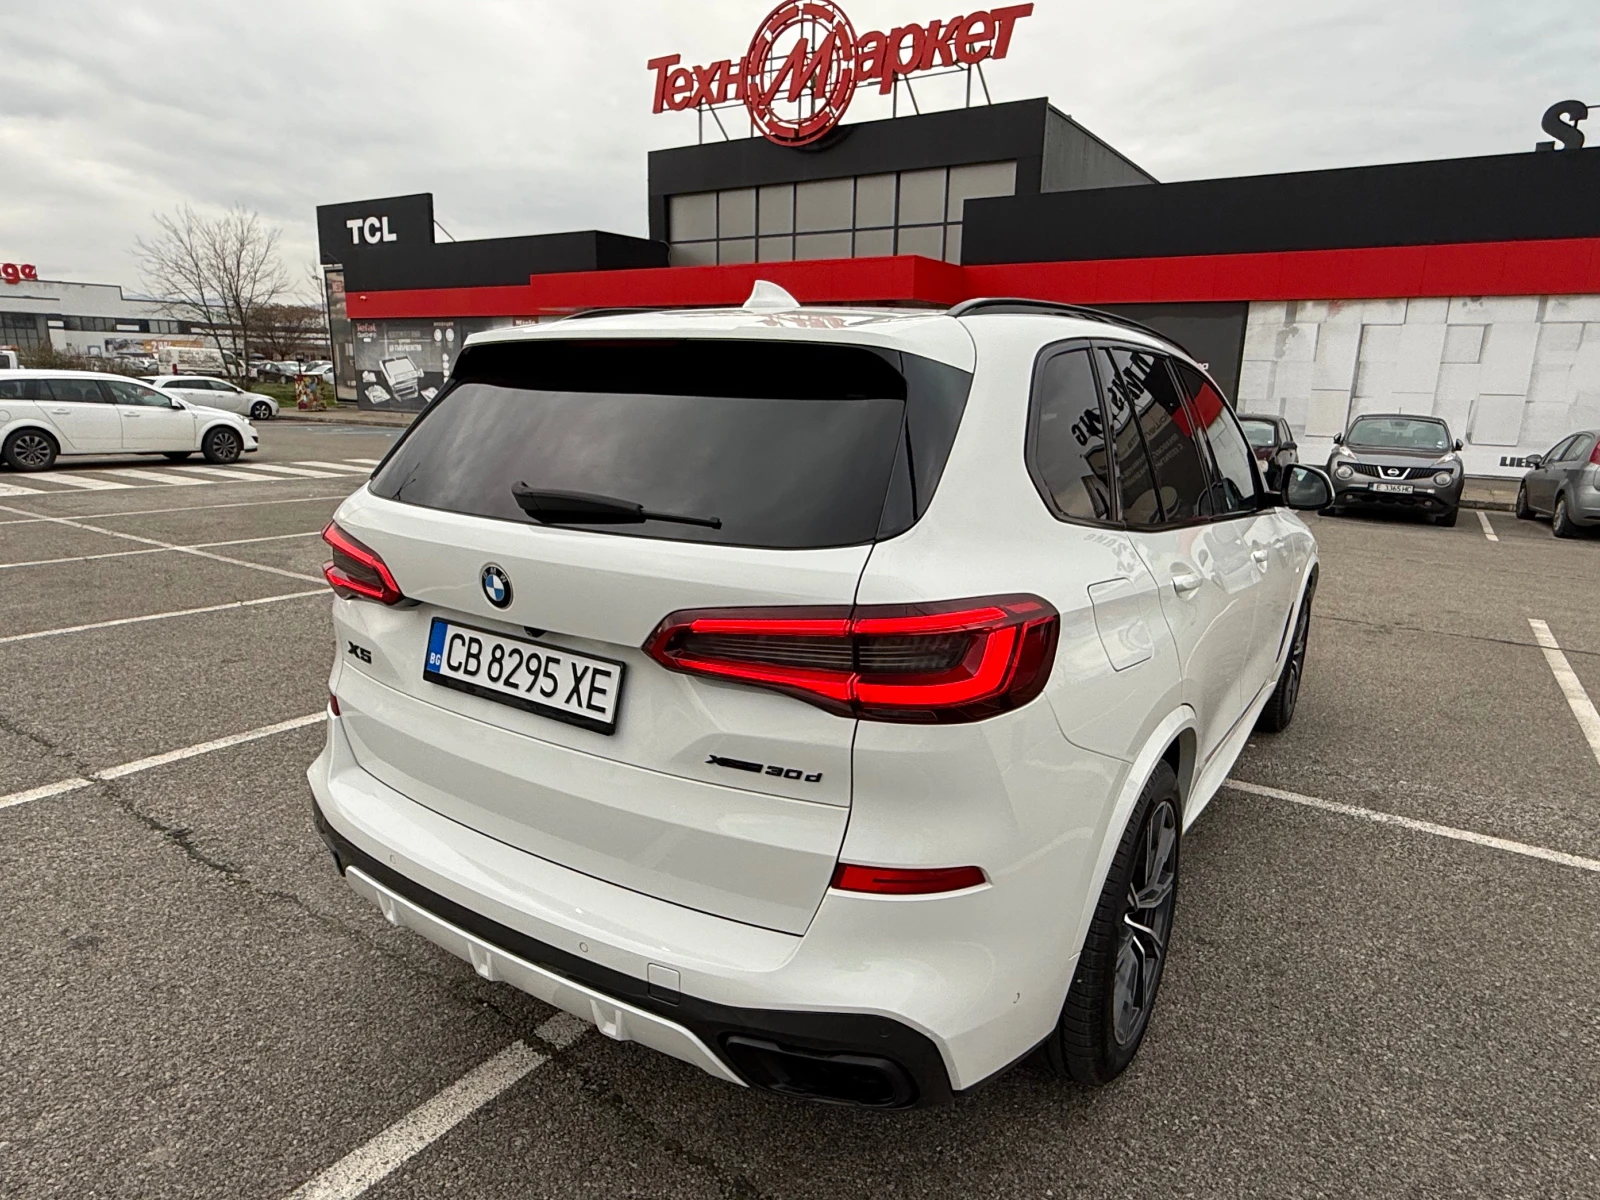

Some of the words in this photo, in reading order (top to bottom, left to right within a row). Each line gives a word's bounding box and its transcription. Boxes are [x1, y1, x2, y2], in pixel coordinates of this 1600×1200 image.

[346, 216, 397, 245] TCL
[356, 323, 377, 332] Tefal
[347, 640, 372, 665] X5
[429, 652, 441, 665] BG
[447, 633, 483, 676] CB
[487, 643, 561, 698] 8295
[564, 661, 612, 714] XE
